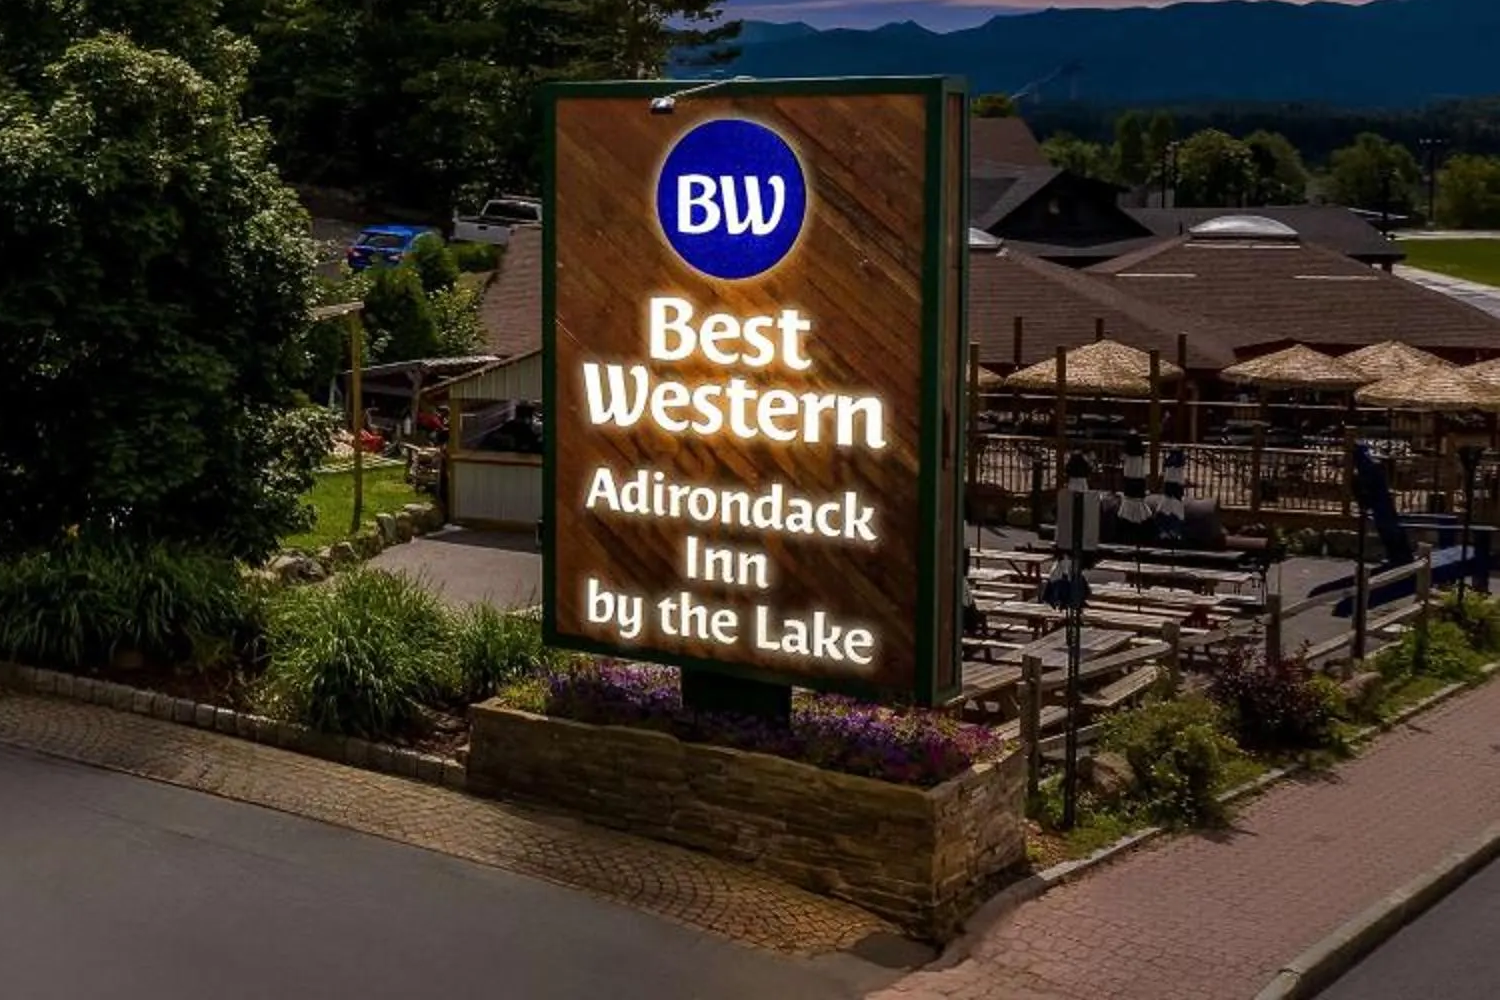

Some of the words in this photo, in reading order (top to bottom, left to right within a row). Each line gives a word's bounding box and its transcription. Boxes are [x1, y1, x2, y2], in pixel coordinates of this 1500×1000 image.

[677, 174, 785, 235] BW
[649, 297, 812, 371] Best
[583, 363, 887, 449] Western
[586, 467, 877, 541] Adirondack
[687, 536, 768, 588] Inn
[588, 578, 642, 639] by
[658, 592, 737, 645] the
[757, 605, 873, 664] Lake
